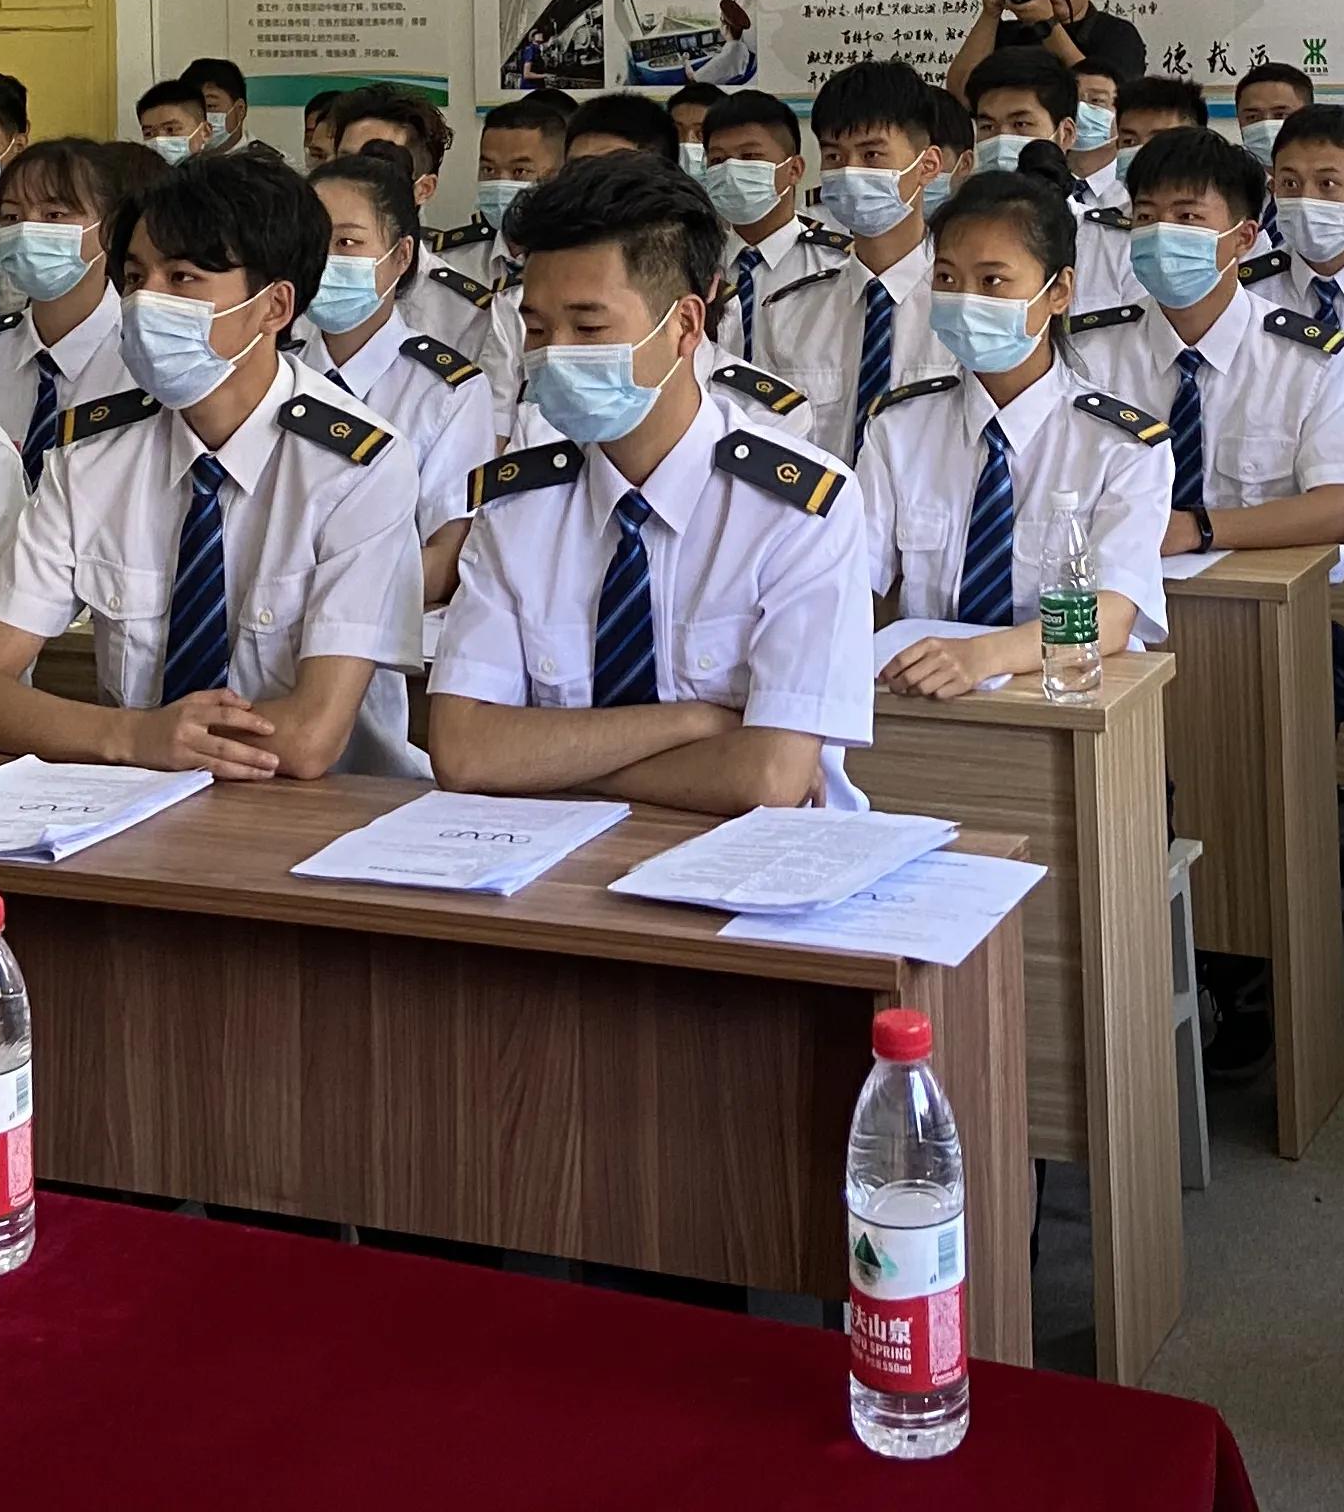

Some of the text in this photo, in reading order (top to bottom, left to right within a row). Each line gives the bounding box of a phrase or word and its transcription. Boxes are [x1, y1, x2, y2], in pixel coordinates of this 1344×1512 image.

[850, 1300, 911, 1345] 夫山泉
[869, 1342, 912, 1361] SPRING
